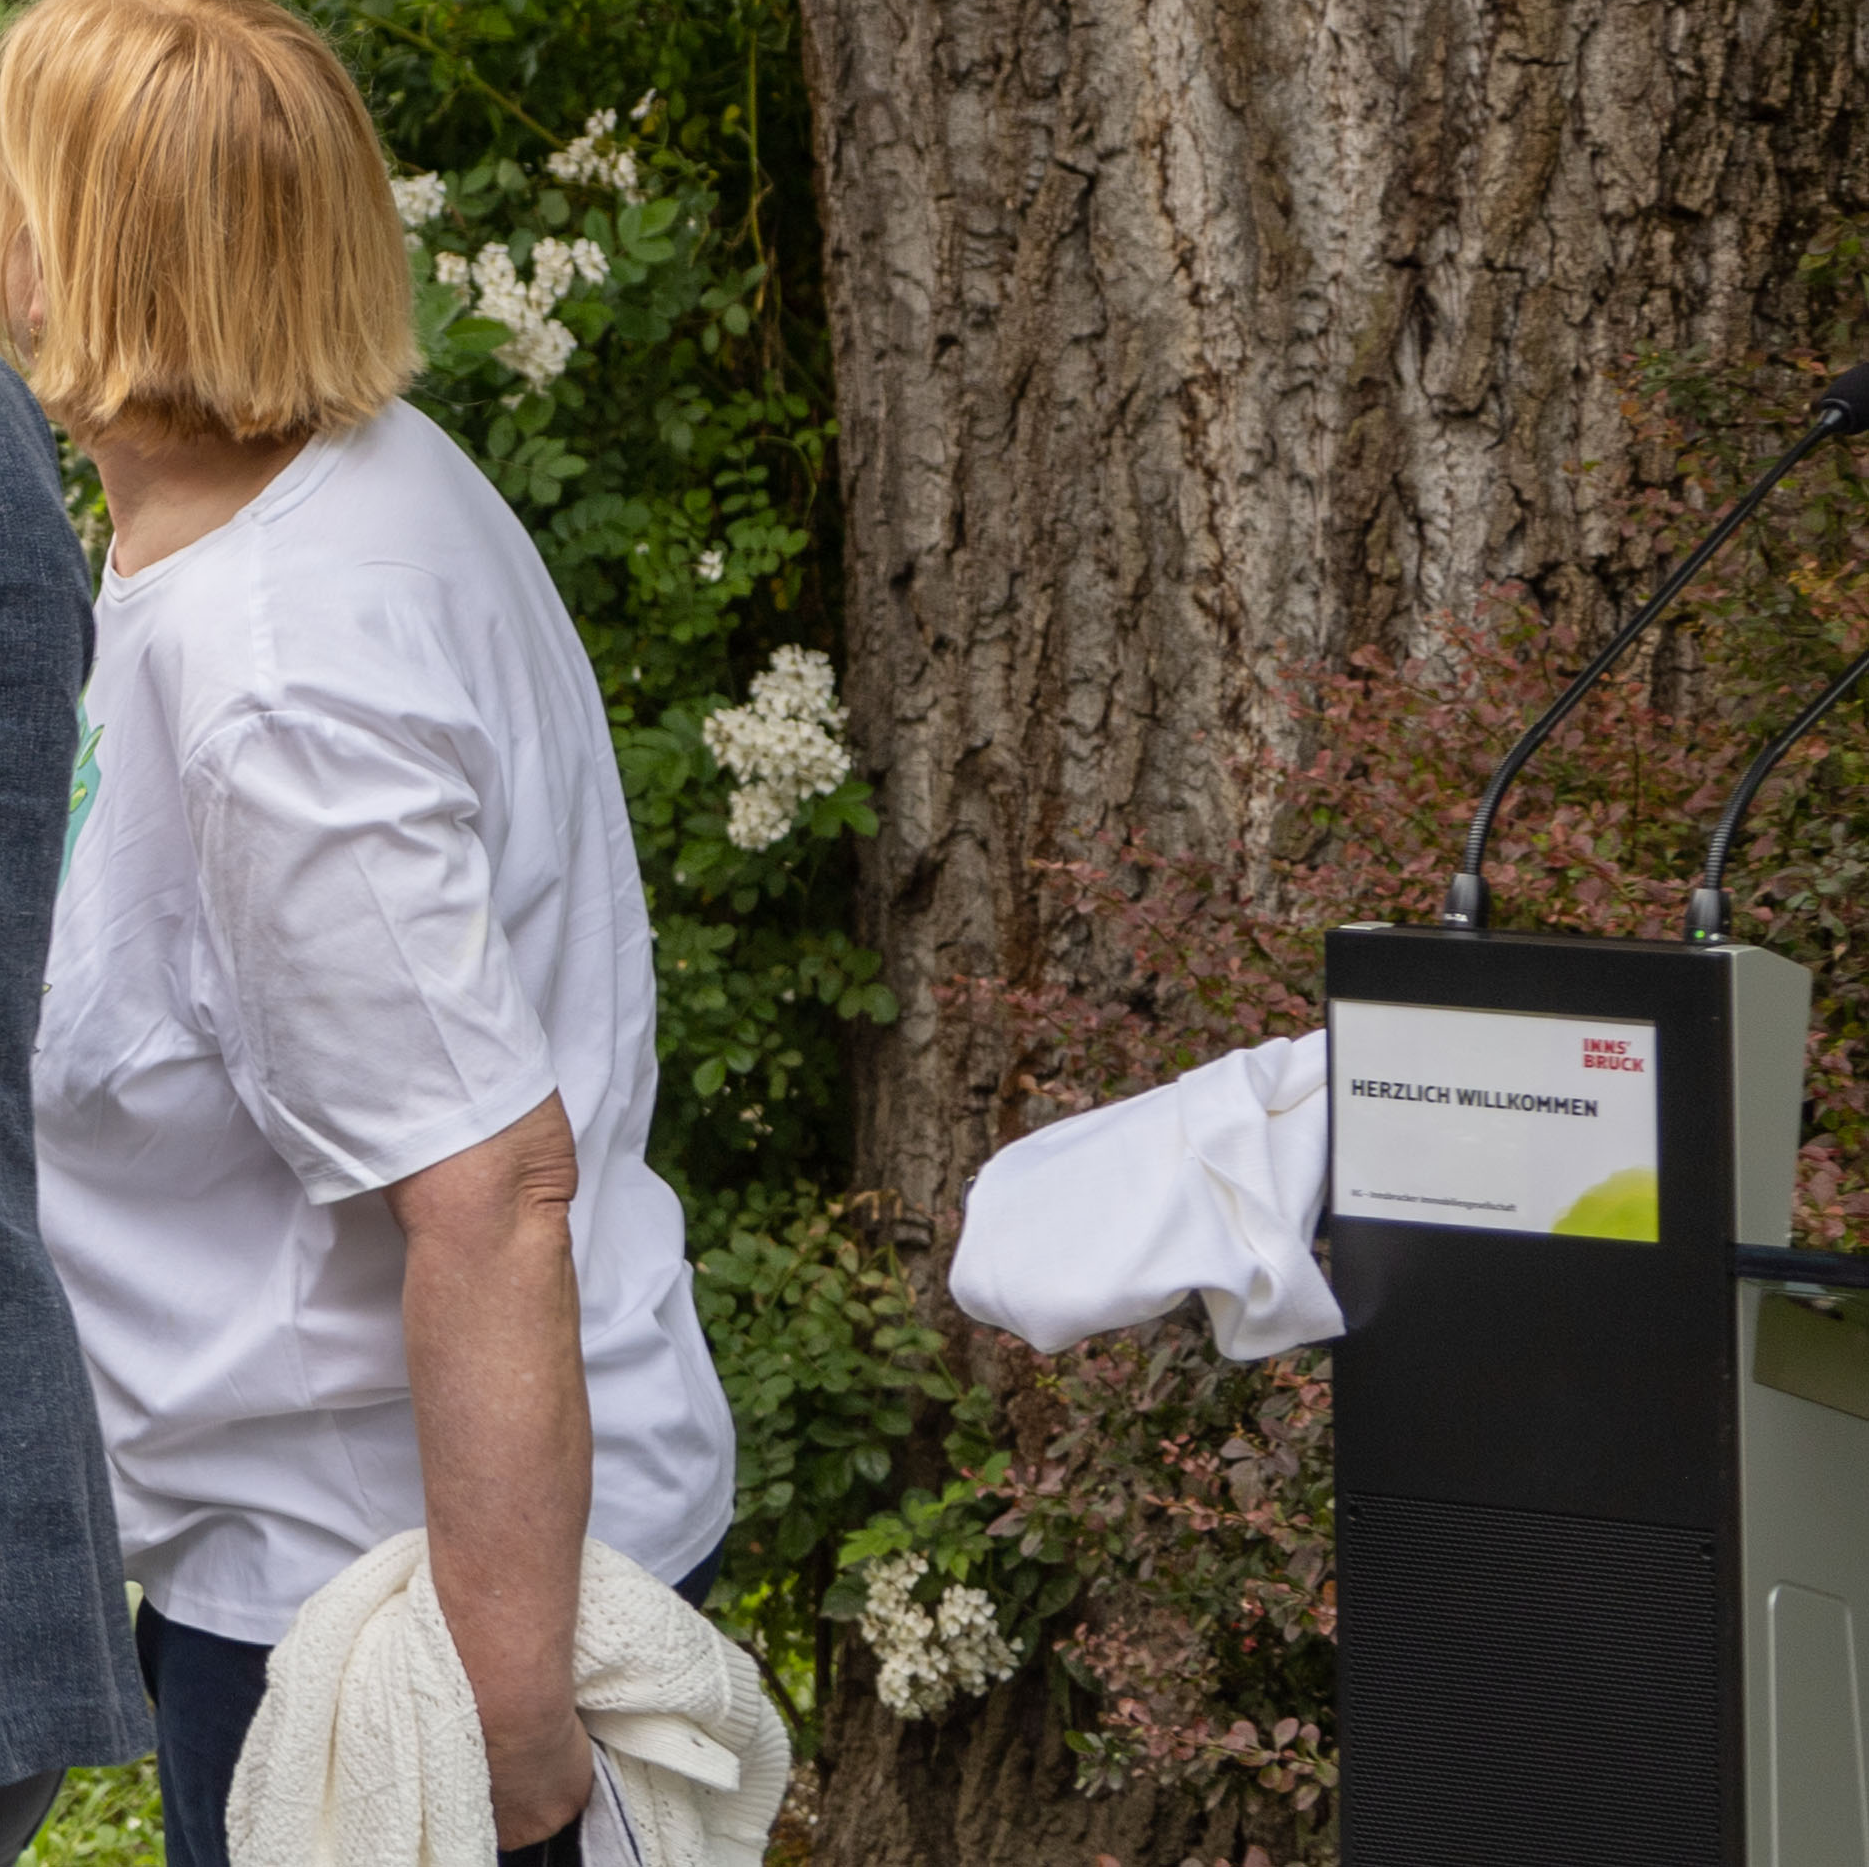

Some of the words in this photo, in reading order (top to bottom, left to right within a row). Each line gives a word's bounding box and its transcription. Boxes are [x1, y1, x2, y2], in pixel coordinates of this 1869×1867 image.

[1582, 1054, 1645, 1072] BRUCK
[1351, 1079, 1450, 1104] HERZLICH
[1456, 1087, 1599, 1118] WILLKOMMEN
